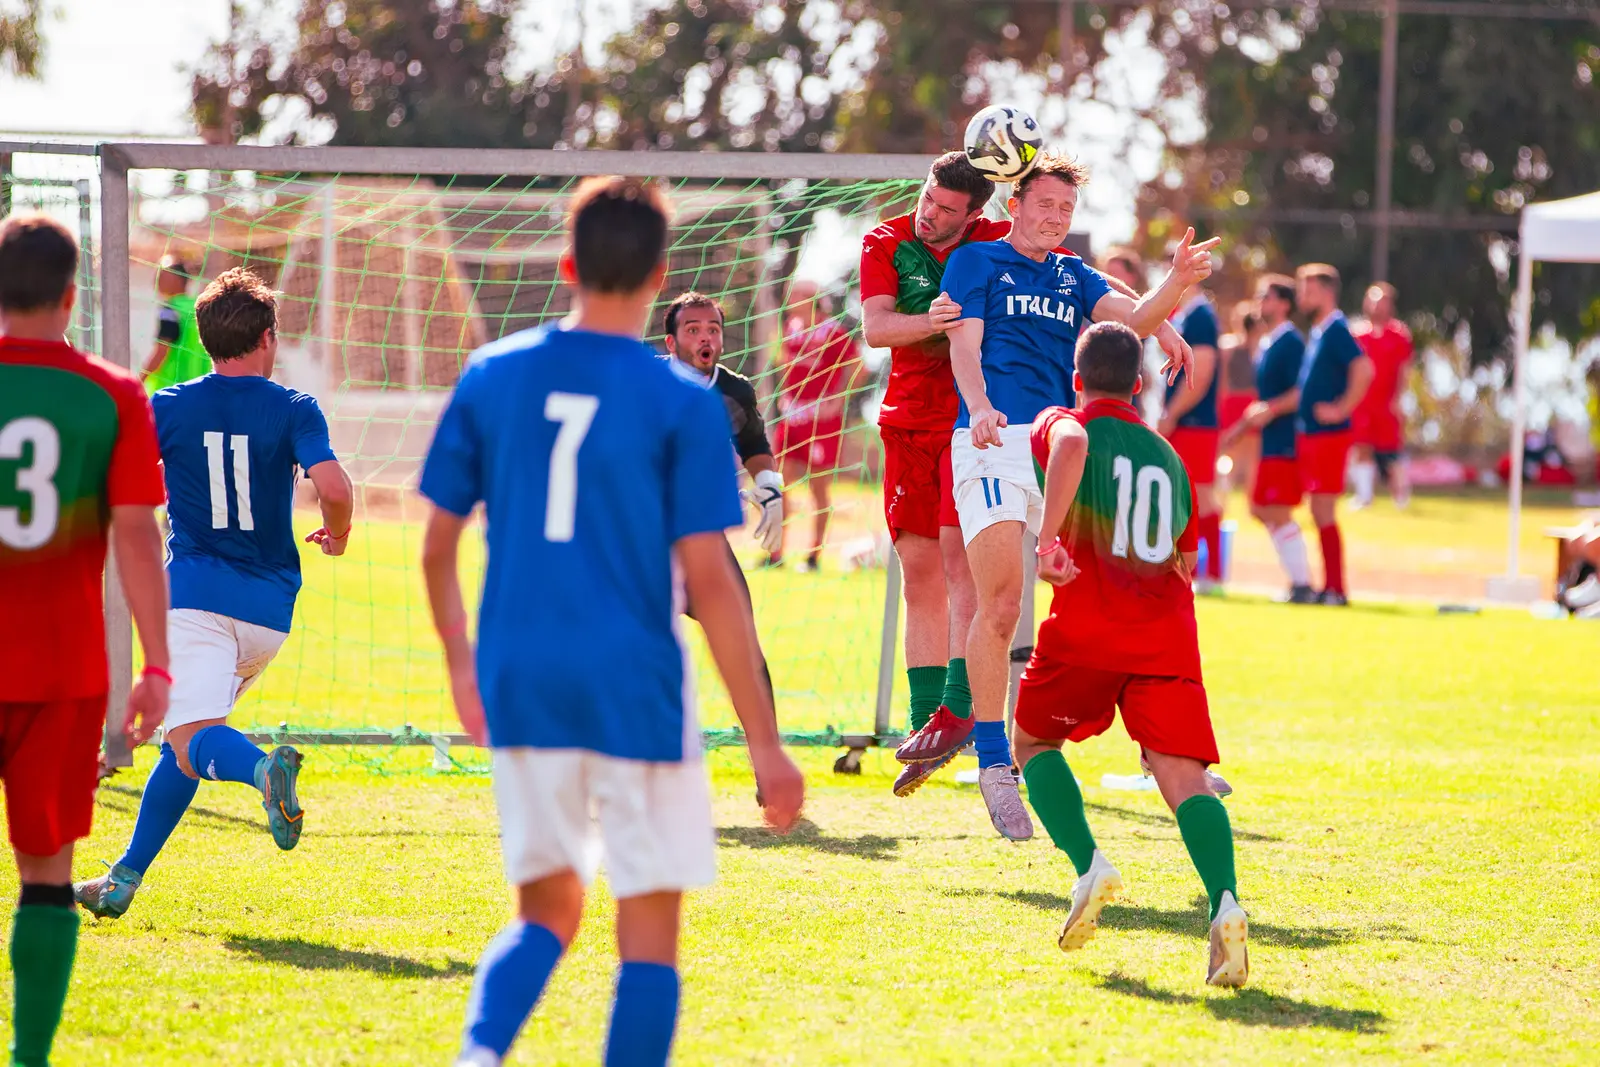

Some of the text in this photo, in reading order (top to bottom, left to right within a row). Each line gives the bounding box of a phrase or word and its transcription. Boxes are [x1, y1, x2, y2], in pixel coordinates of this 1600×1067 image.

[1006, 294, 1075, 328] ITALIA
[0, 415, 60, 550] 3
[203, 431, 254, 531] 11
[544, 391, 600, 543] 7
[1111, 454, 1174, 564] 10
